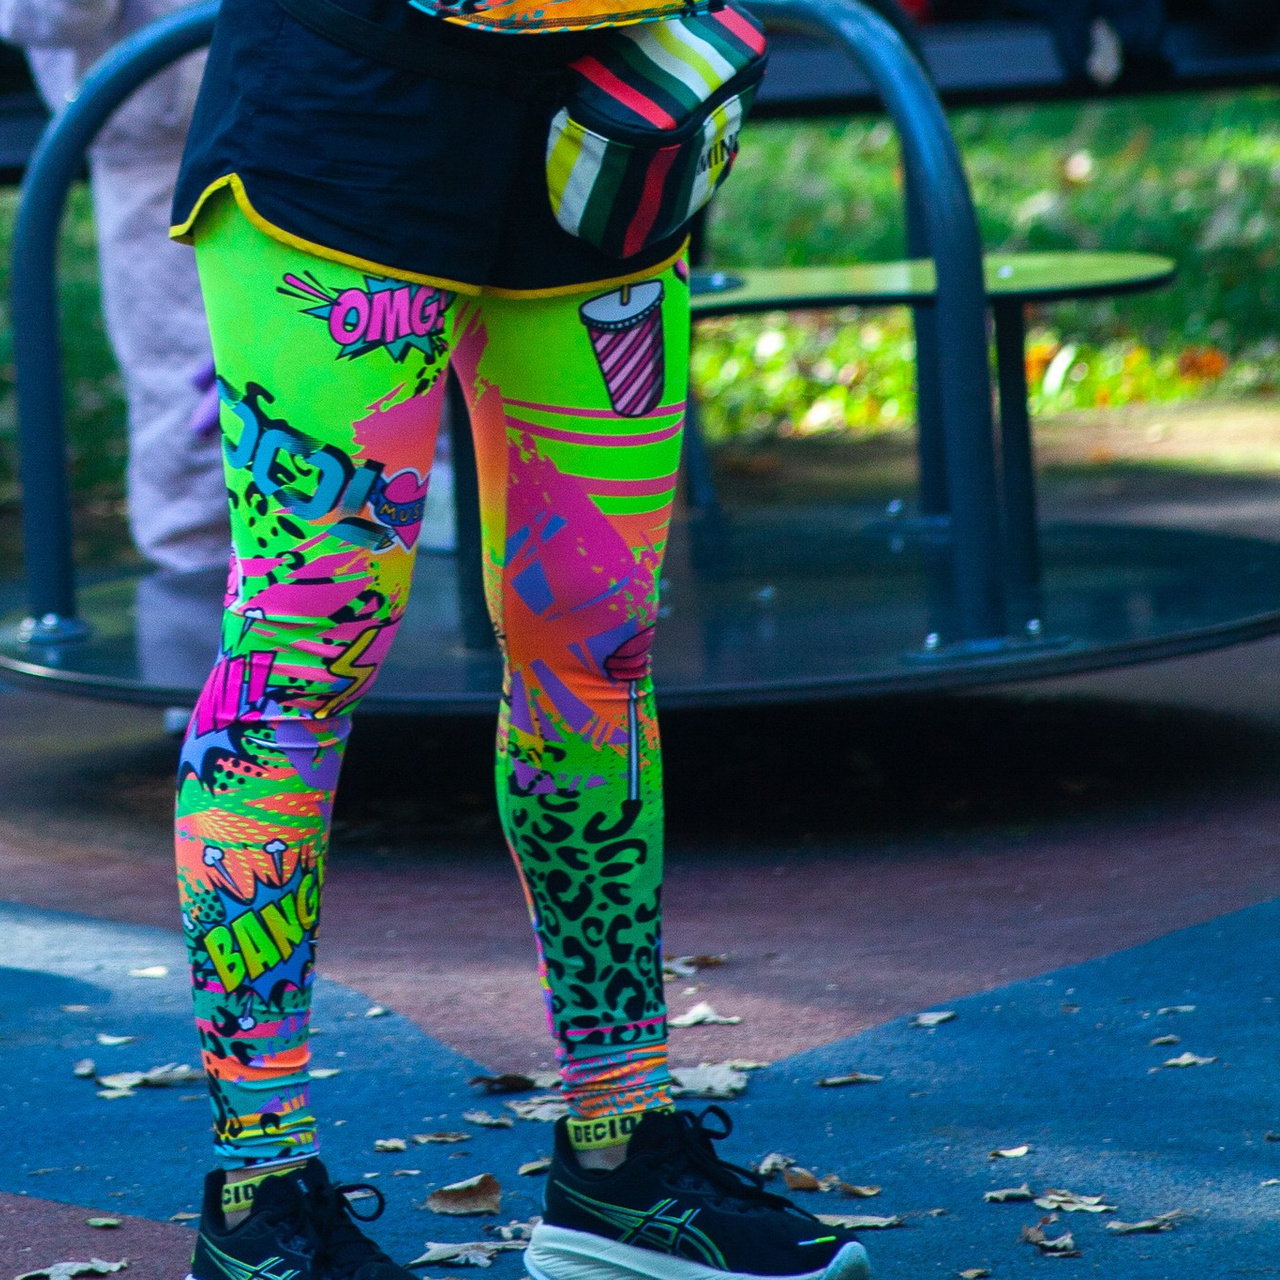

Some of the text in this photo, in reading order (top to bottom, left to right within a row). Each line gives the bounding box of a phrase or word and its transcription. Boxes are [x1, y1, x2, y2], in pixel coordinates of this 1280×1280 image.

[329, 286, 447, 345] OMG!
[379, 502, 426, 523] MUS
[573, 1115, 638, 1143] DECID
